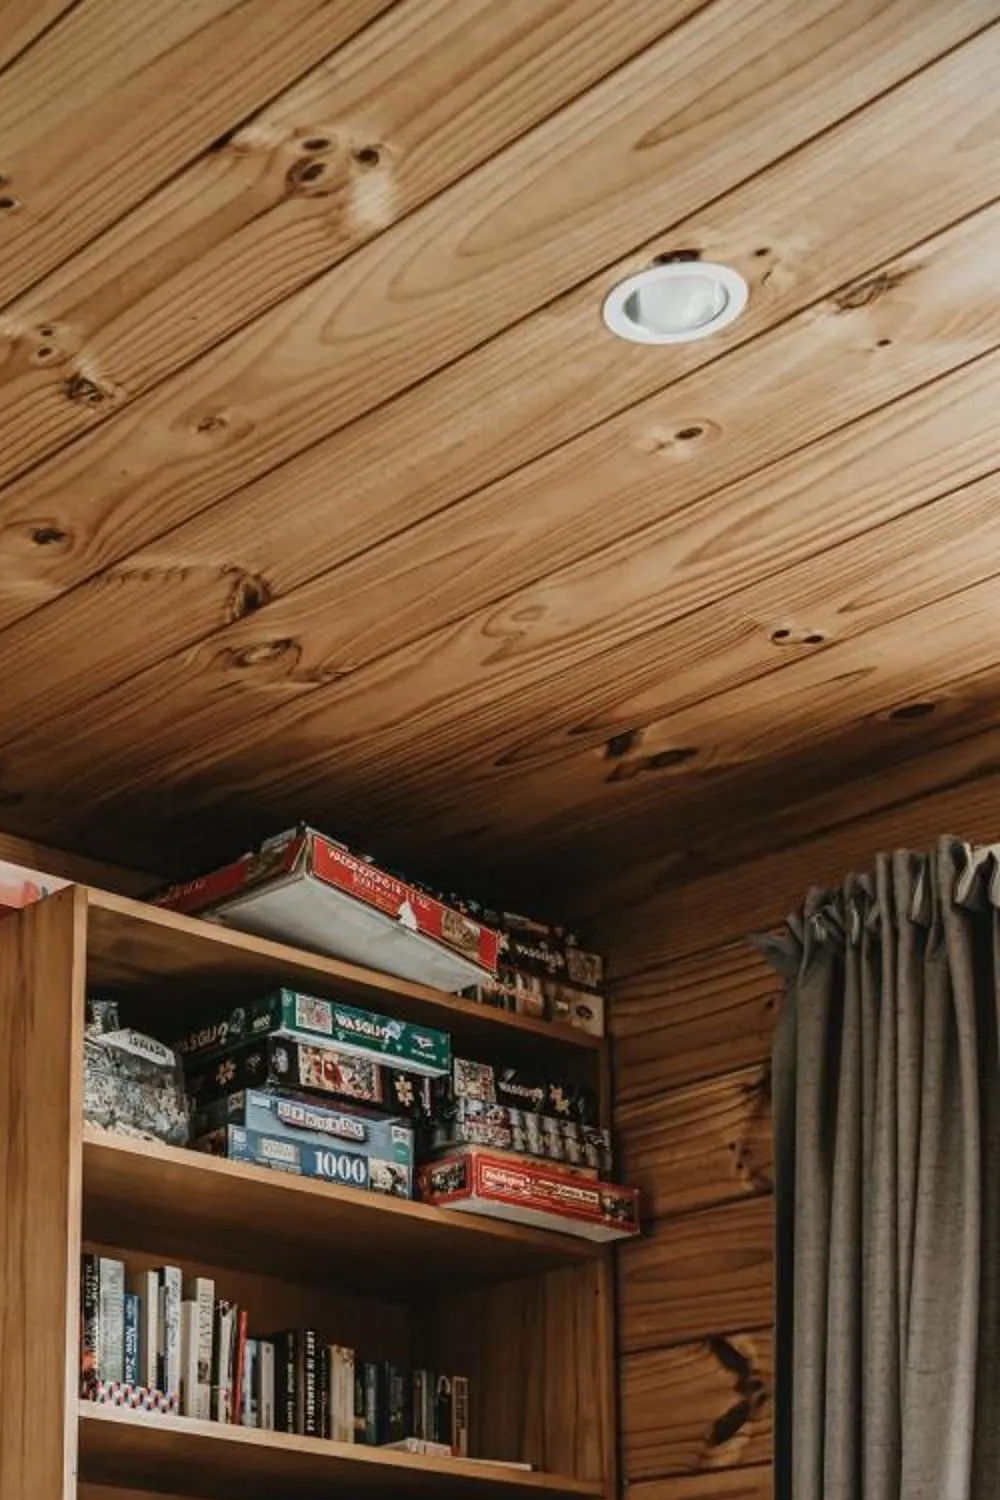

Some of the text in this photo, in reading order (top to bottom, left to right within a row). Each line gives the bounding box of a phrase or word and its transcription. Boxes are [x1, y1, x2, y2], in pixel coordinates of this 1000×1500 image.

[313, 1150, 367, 1185] 1000
[126, 1325, 136, 1353] New
[125, 1356, 135, 1384] Zeal
